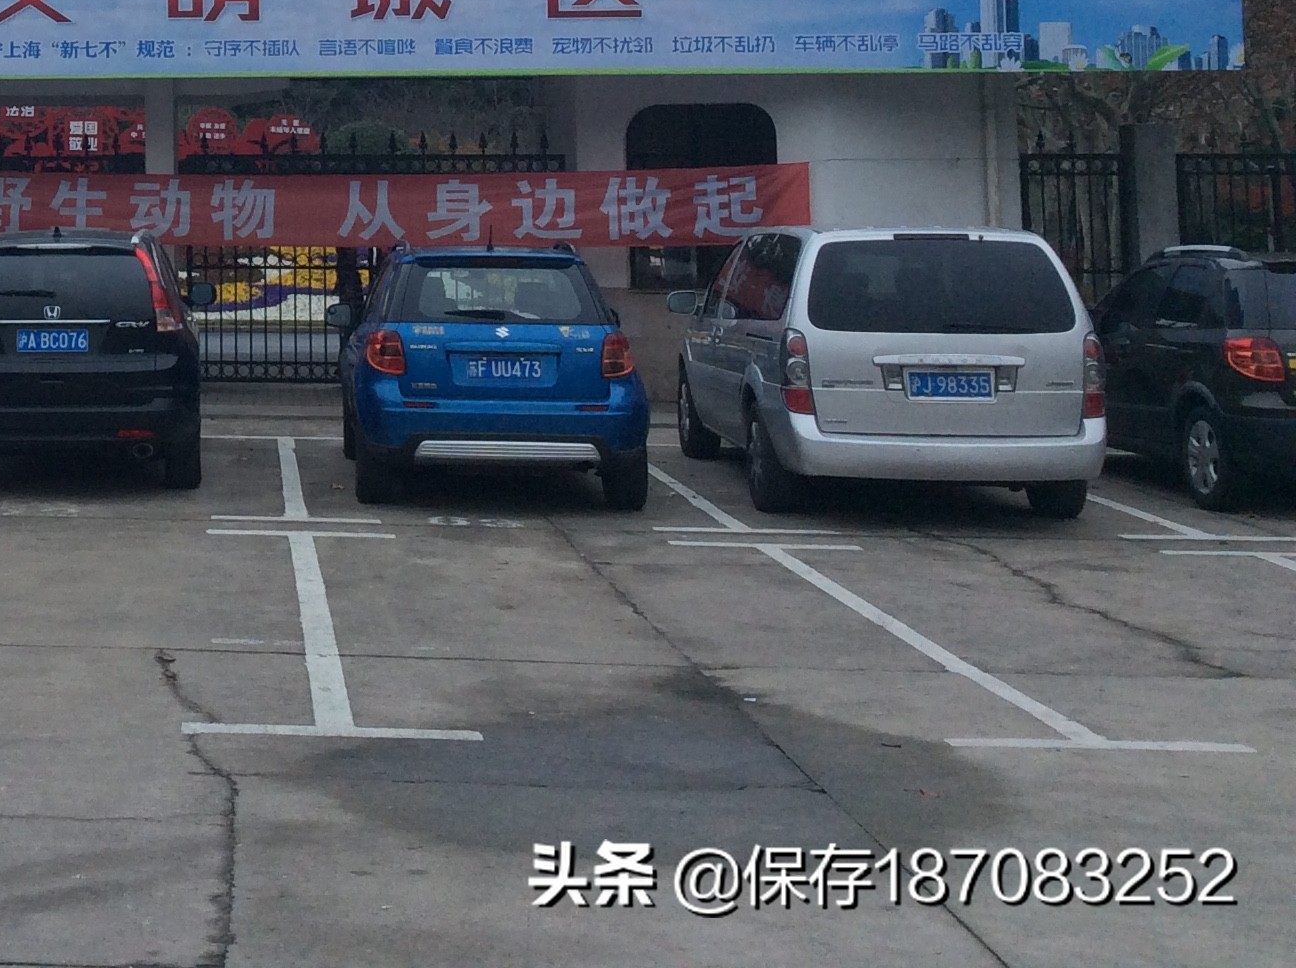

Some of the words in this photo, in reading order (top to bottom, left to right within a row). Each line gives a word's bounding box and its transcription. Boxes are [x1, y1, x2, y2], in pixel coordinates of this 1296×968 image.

[204, 39, 300, 57] 守序不插队
[318, 38, 416, 57] 言语不喧哗
[552, 37, 653, 55] 宠物不扰邻
[671, 37, 775, 55] 垃圾不乱扔
[794, 35, 899, 53] 车辆不乱停
[918, 32, 1024, 53] 马路不乱穿
[338, 173, 764, 241] 从身边做起
